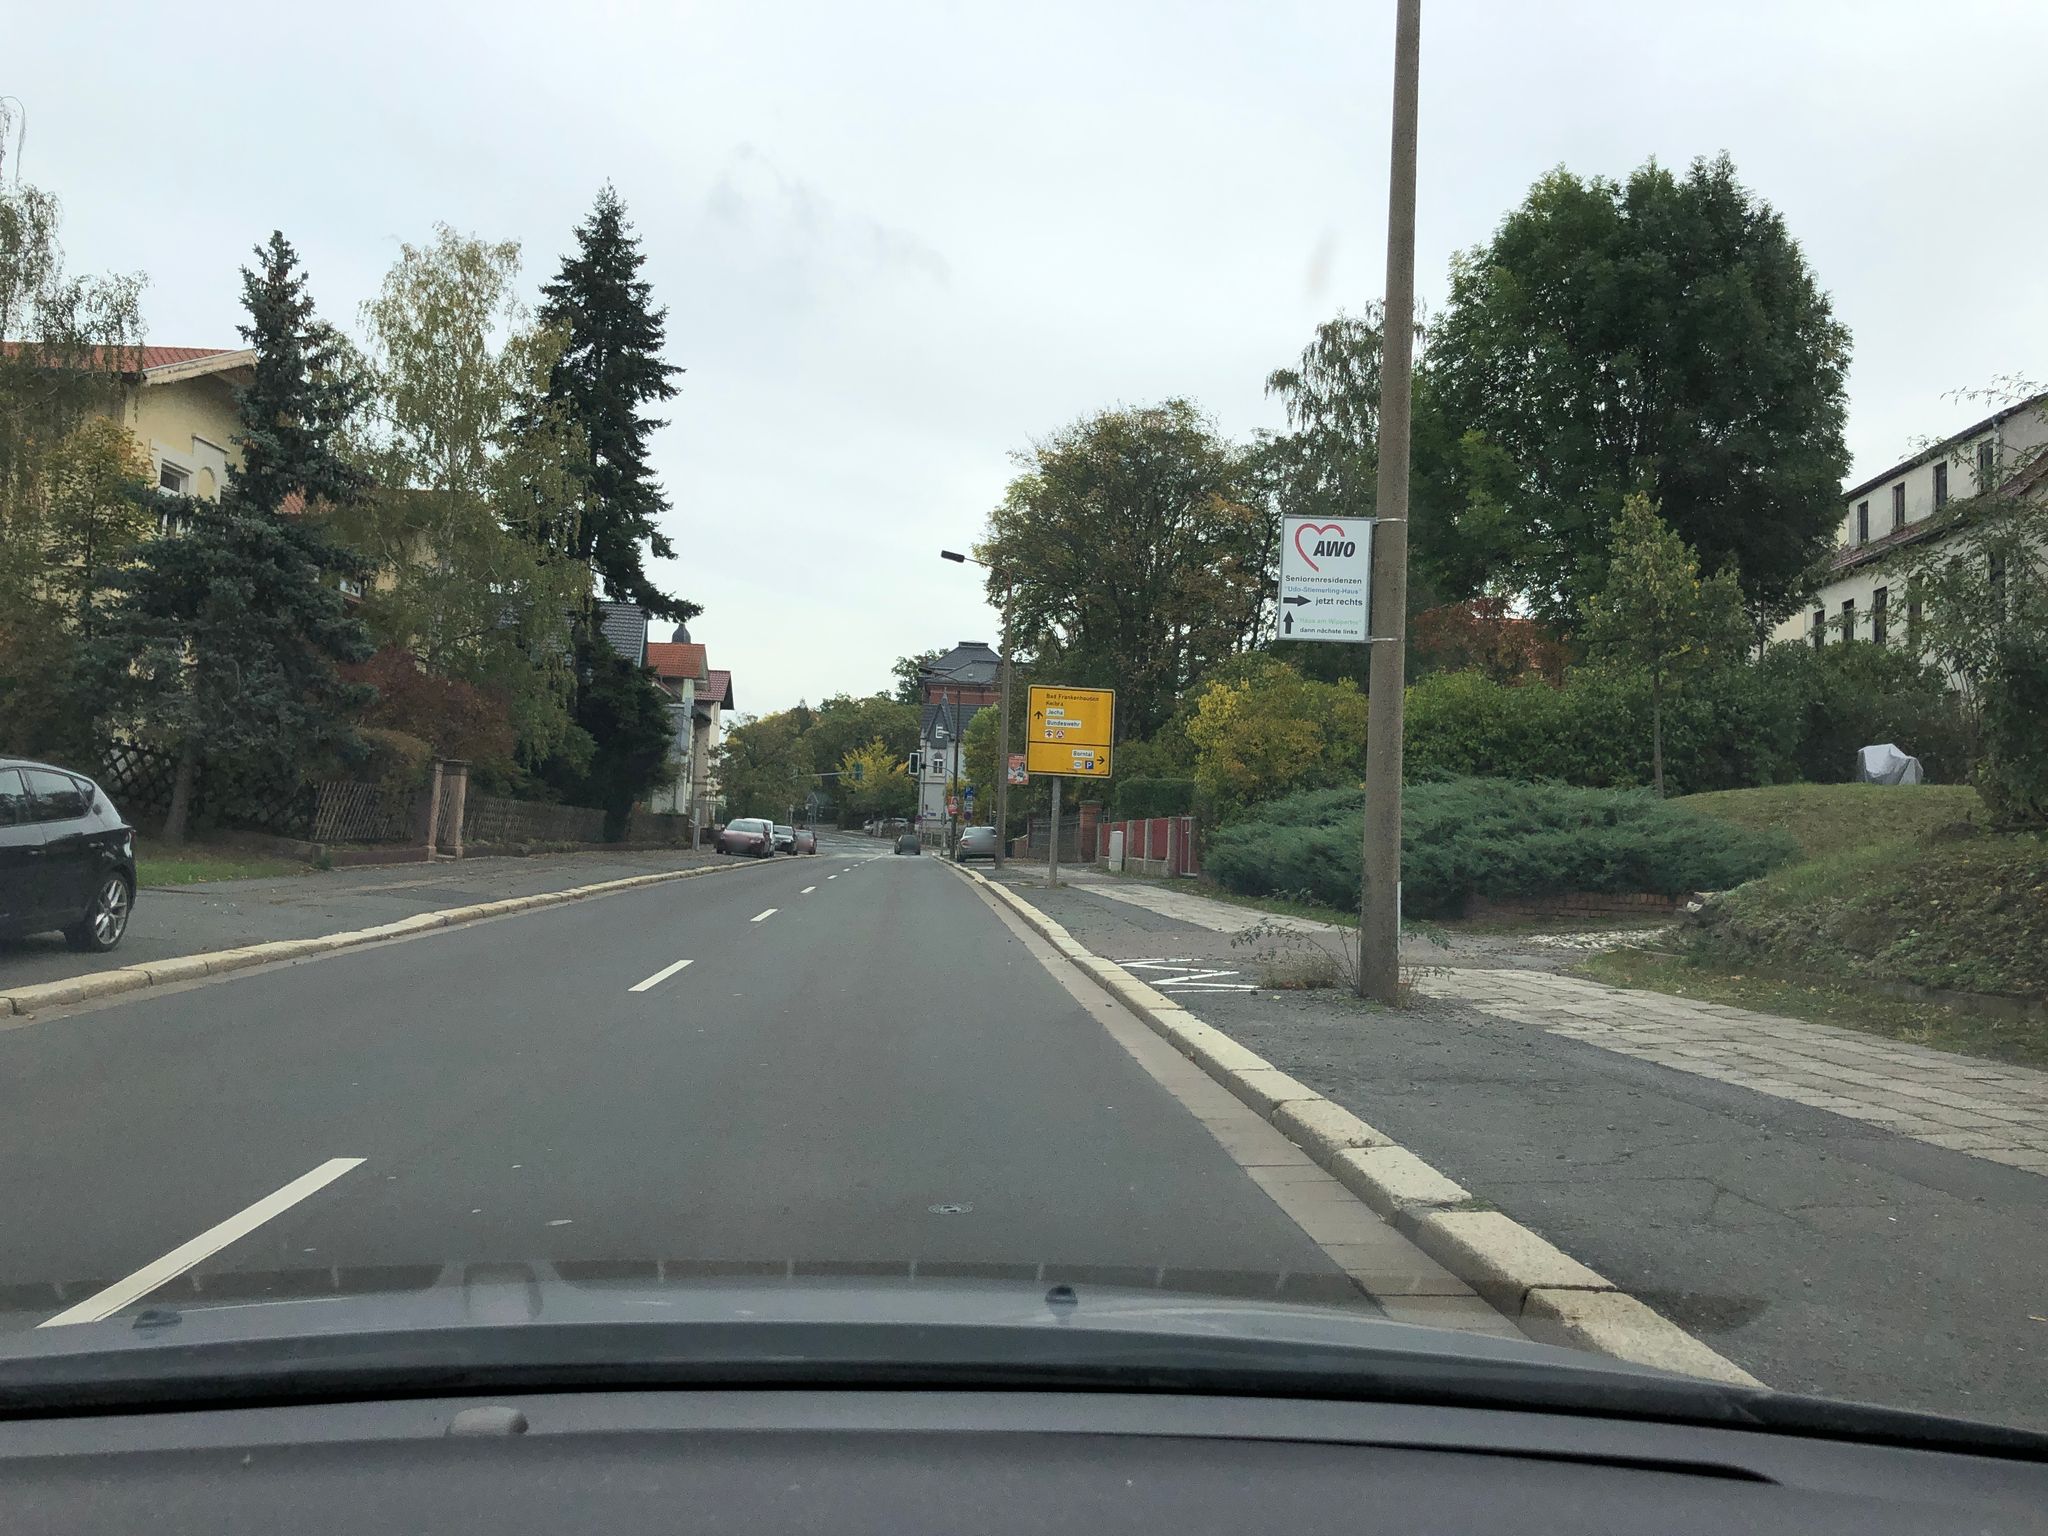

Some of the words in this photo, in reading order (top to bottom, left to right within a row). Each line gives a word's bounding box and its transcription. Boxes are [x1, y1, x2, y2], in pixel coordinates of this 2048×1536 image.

[1313, 540, 1356, 558] AWO
[1285, 575, 1362, 584] Seniorenresidenzen
[1315, 596, 1334, 606] jetzt
[1336, 598, 1363, 606] rechts
